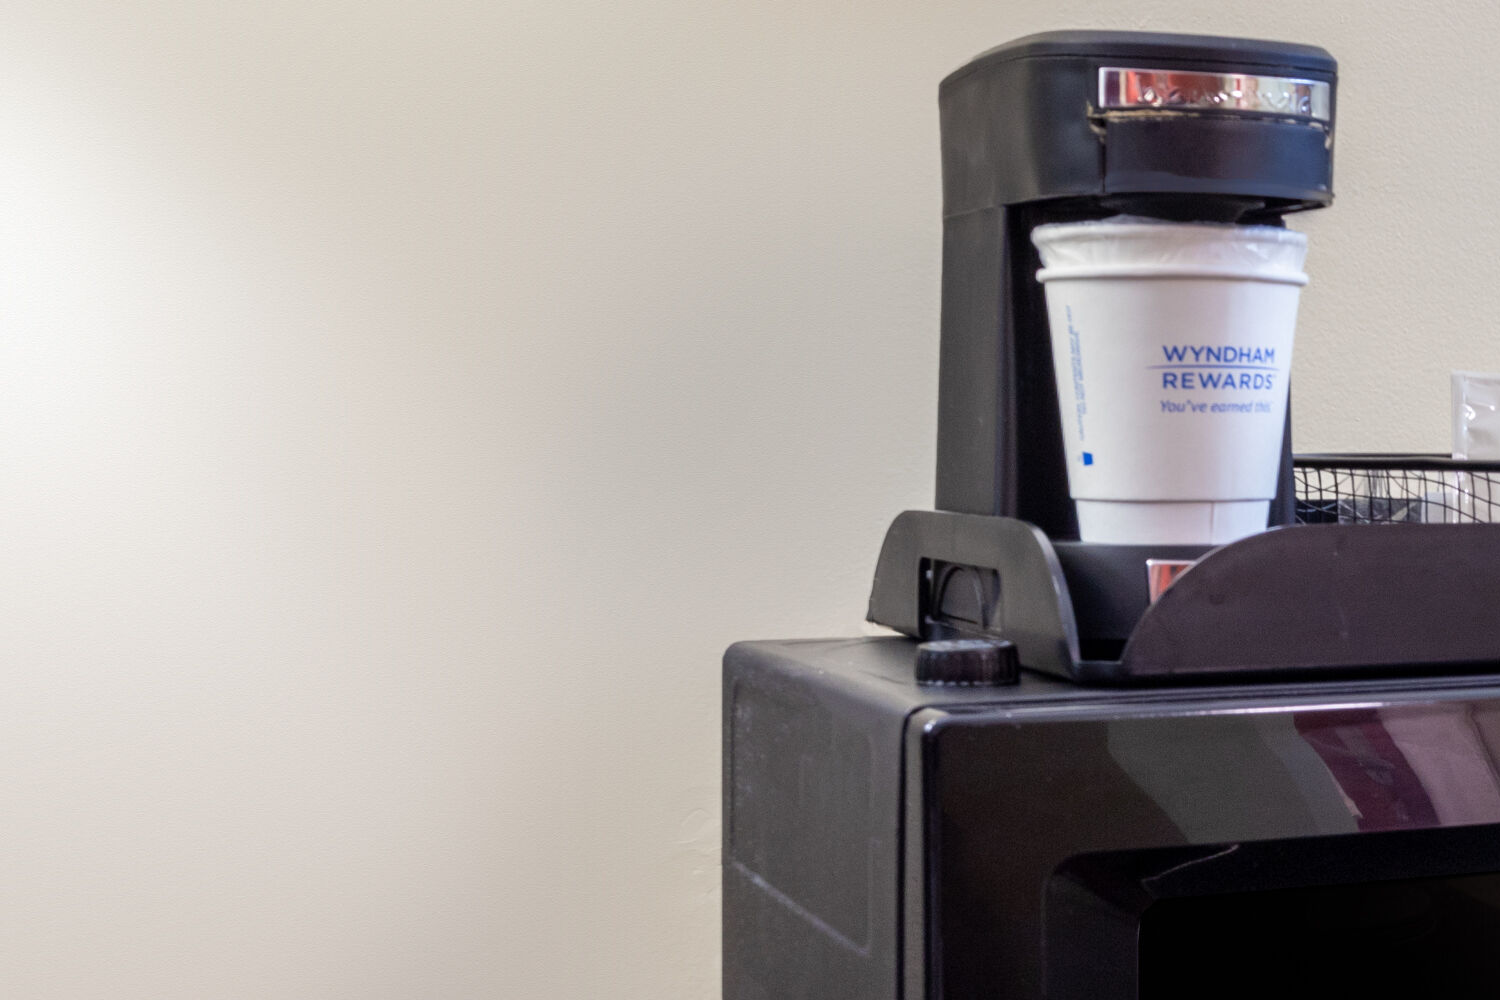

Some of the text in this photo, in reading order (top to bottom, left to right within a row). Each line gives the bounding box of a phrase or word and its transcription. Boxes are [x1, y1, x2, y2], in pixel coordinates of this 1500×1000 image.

[1163, 345, 1275, 364] WYNDHAM
[1163, 373, 1273, 390] REWARDS
[1160, 400, 1208, 412] You've
[1210, 401, 1253, 413] earned
